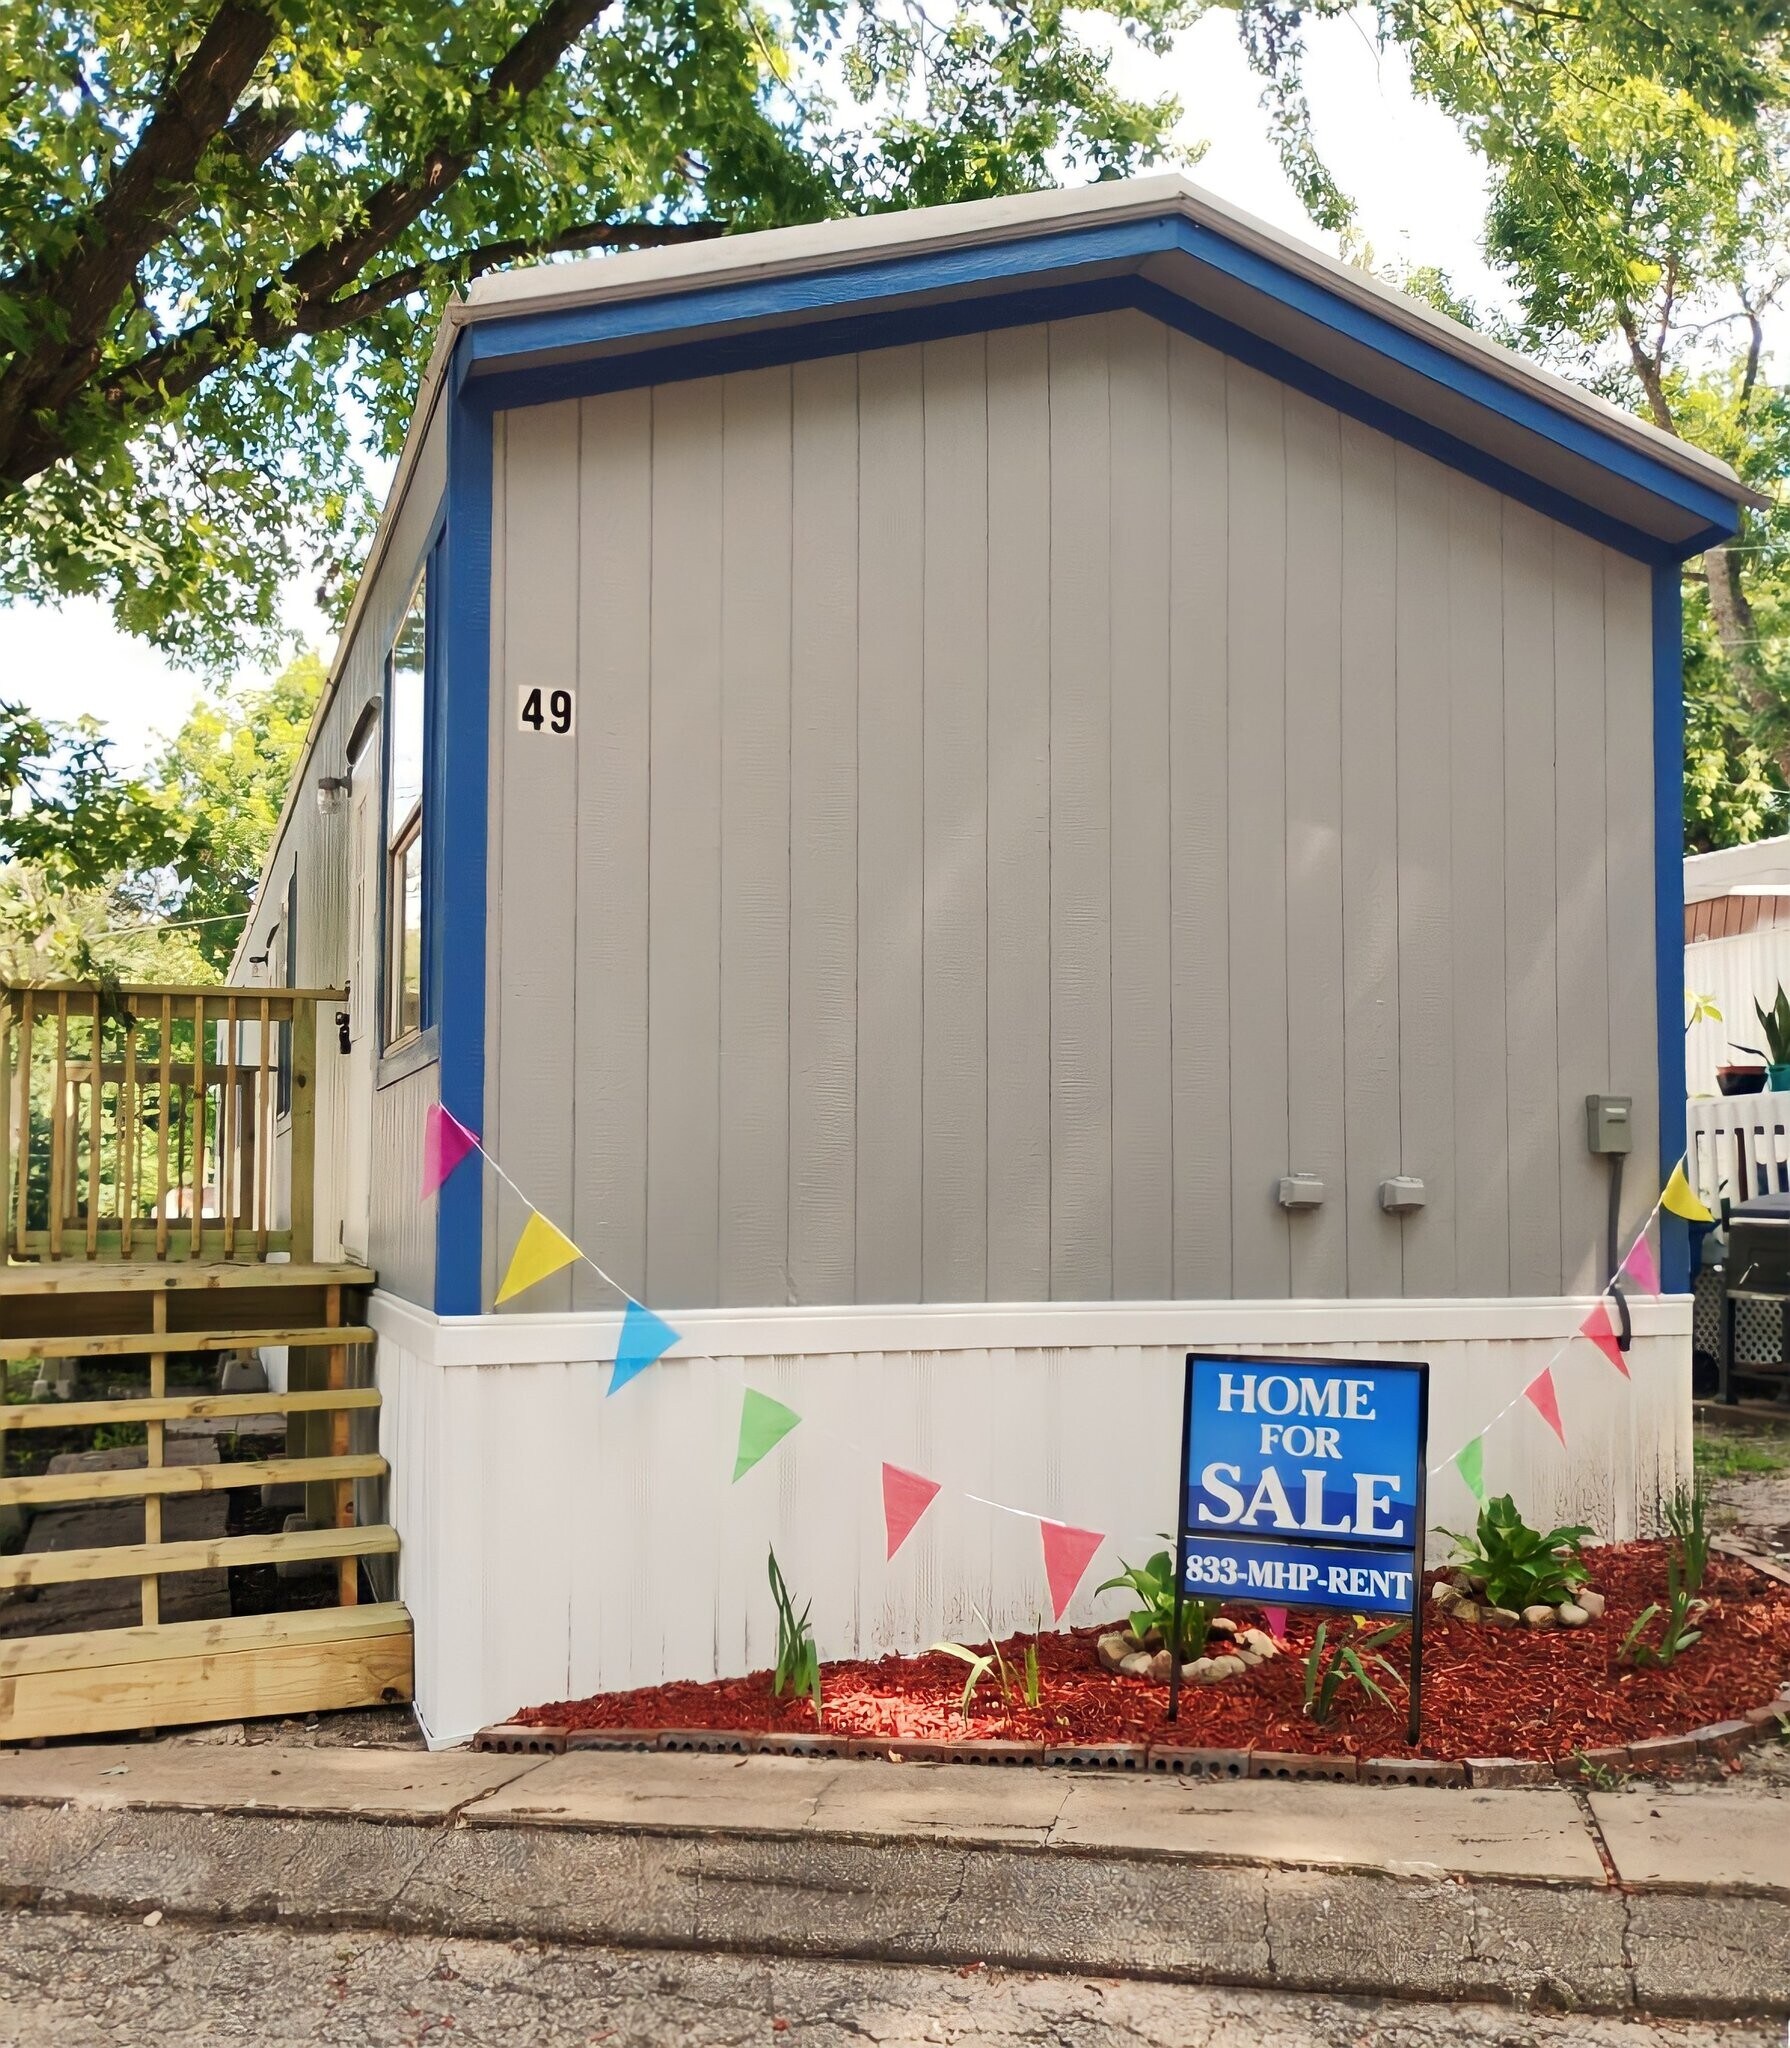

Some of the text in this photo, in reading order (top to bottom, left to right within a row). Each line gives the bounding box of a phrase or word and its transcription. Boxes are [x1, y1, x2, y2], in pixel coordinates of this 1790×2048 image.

[522, 688, 571, 734] 49
[1217, 1373, 1376, 1420] HOME
[1259, 1423, 1343, 1459] FOR
[1198, 1462, 1404, 1538] SALE
[1185, 1554, 1413, 1600] 833-MHP-RENT
